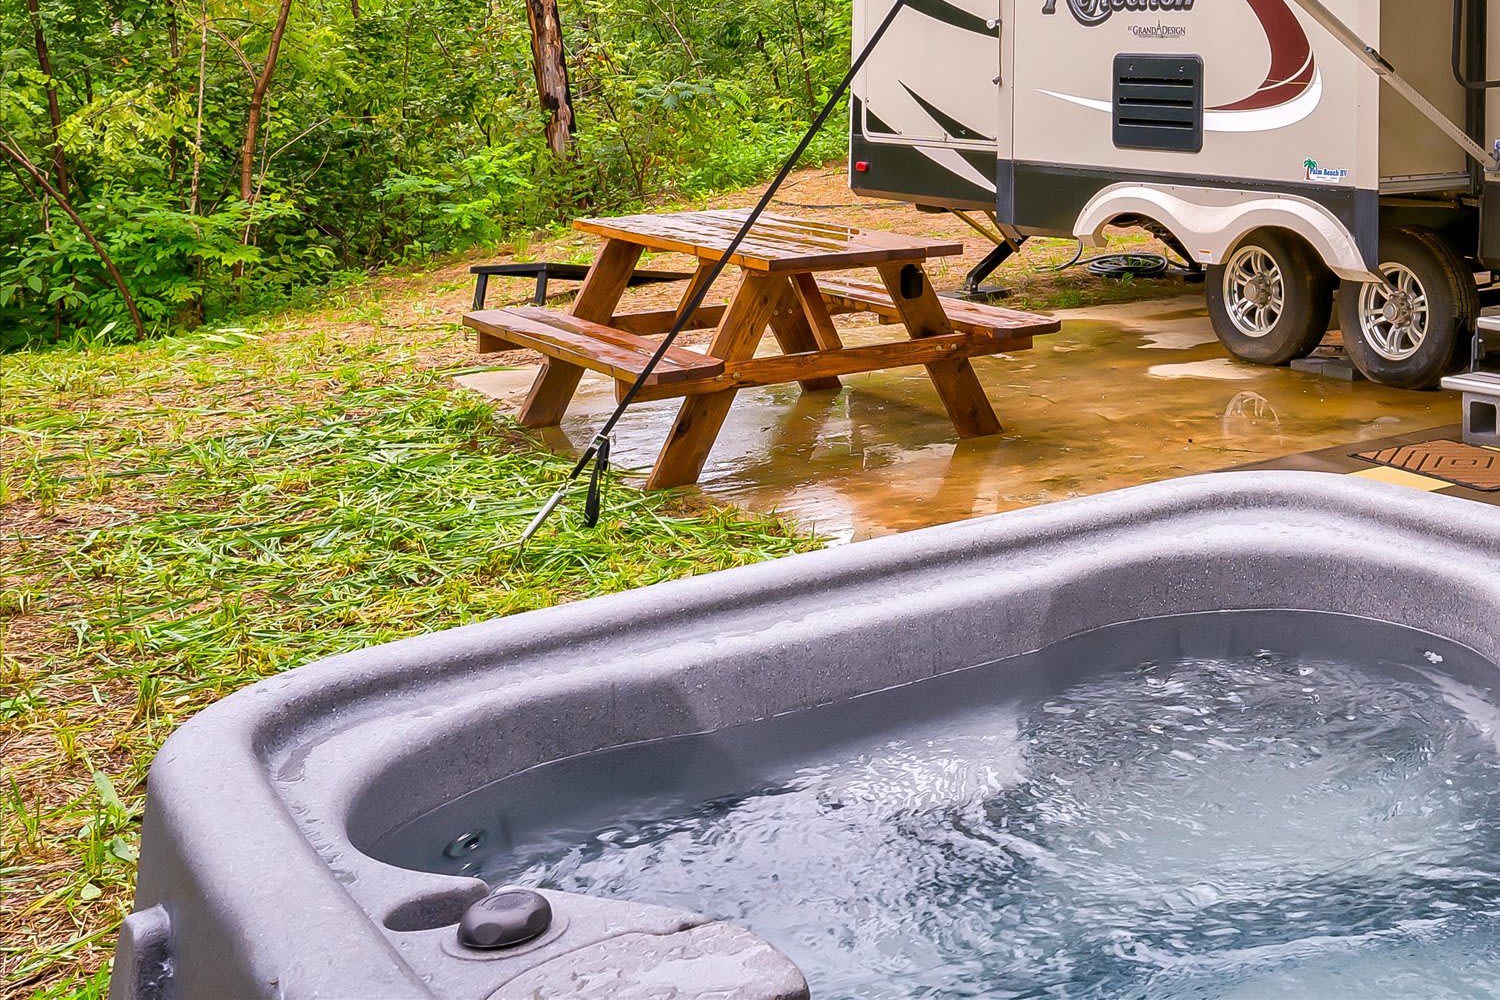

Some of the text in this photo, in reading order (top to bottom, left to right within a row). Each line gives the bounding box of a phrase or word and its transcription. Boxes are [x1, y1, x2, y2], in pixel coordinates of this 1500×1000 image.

[1132, 25, 1157, 35] GRAND
[1162, 25, 1186, 35] DESIGN
[1323, 168, 1339, 176] Beach
